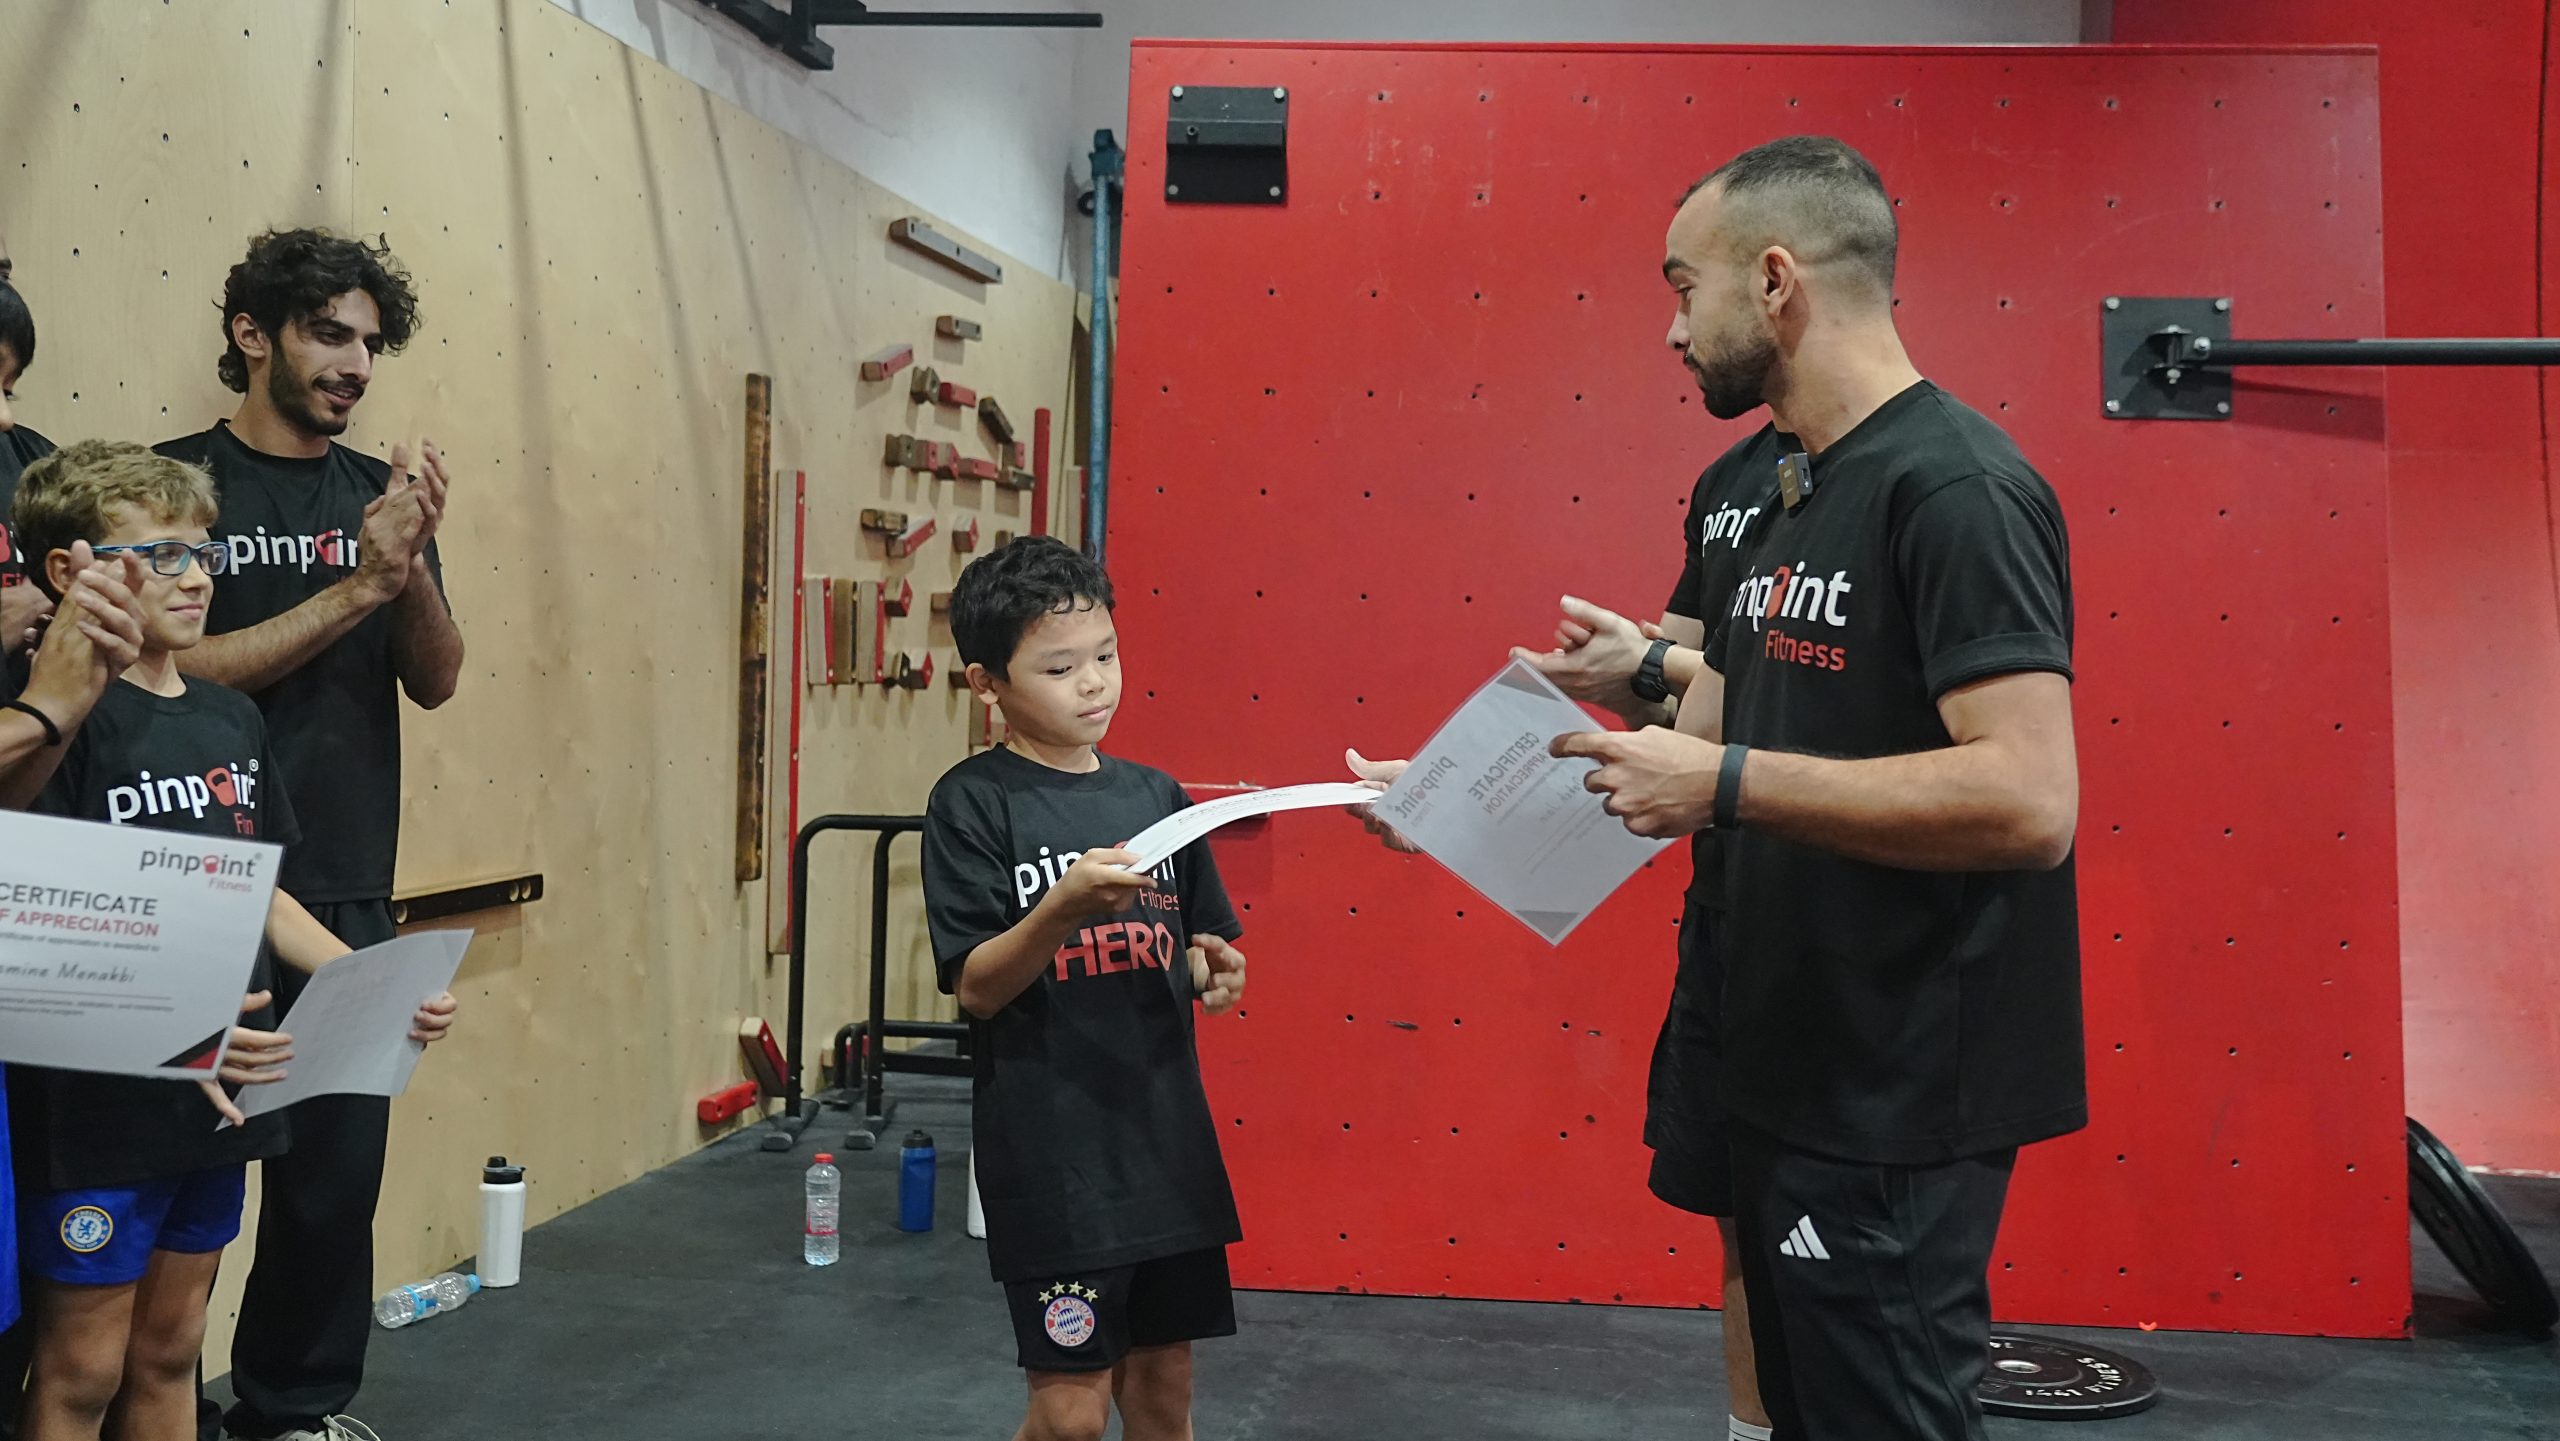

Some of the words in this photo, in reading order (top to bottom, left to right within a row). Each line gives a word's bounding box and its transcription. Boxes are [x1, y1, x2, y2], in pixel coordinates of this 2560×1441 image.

[227, 525, 358, 575] pinpoi
[1731, 561, 1852, 633] inpoint
[1765, 629, 1847, 672] Fitness
[0, 882, 158, 917] CERTIFICATE
[0, 907, 11, 920] F
[14, 910, 160, 937] APPRECIATION
[1054, 921, 1174, 982] HERO
